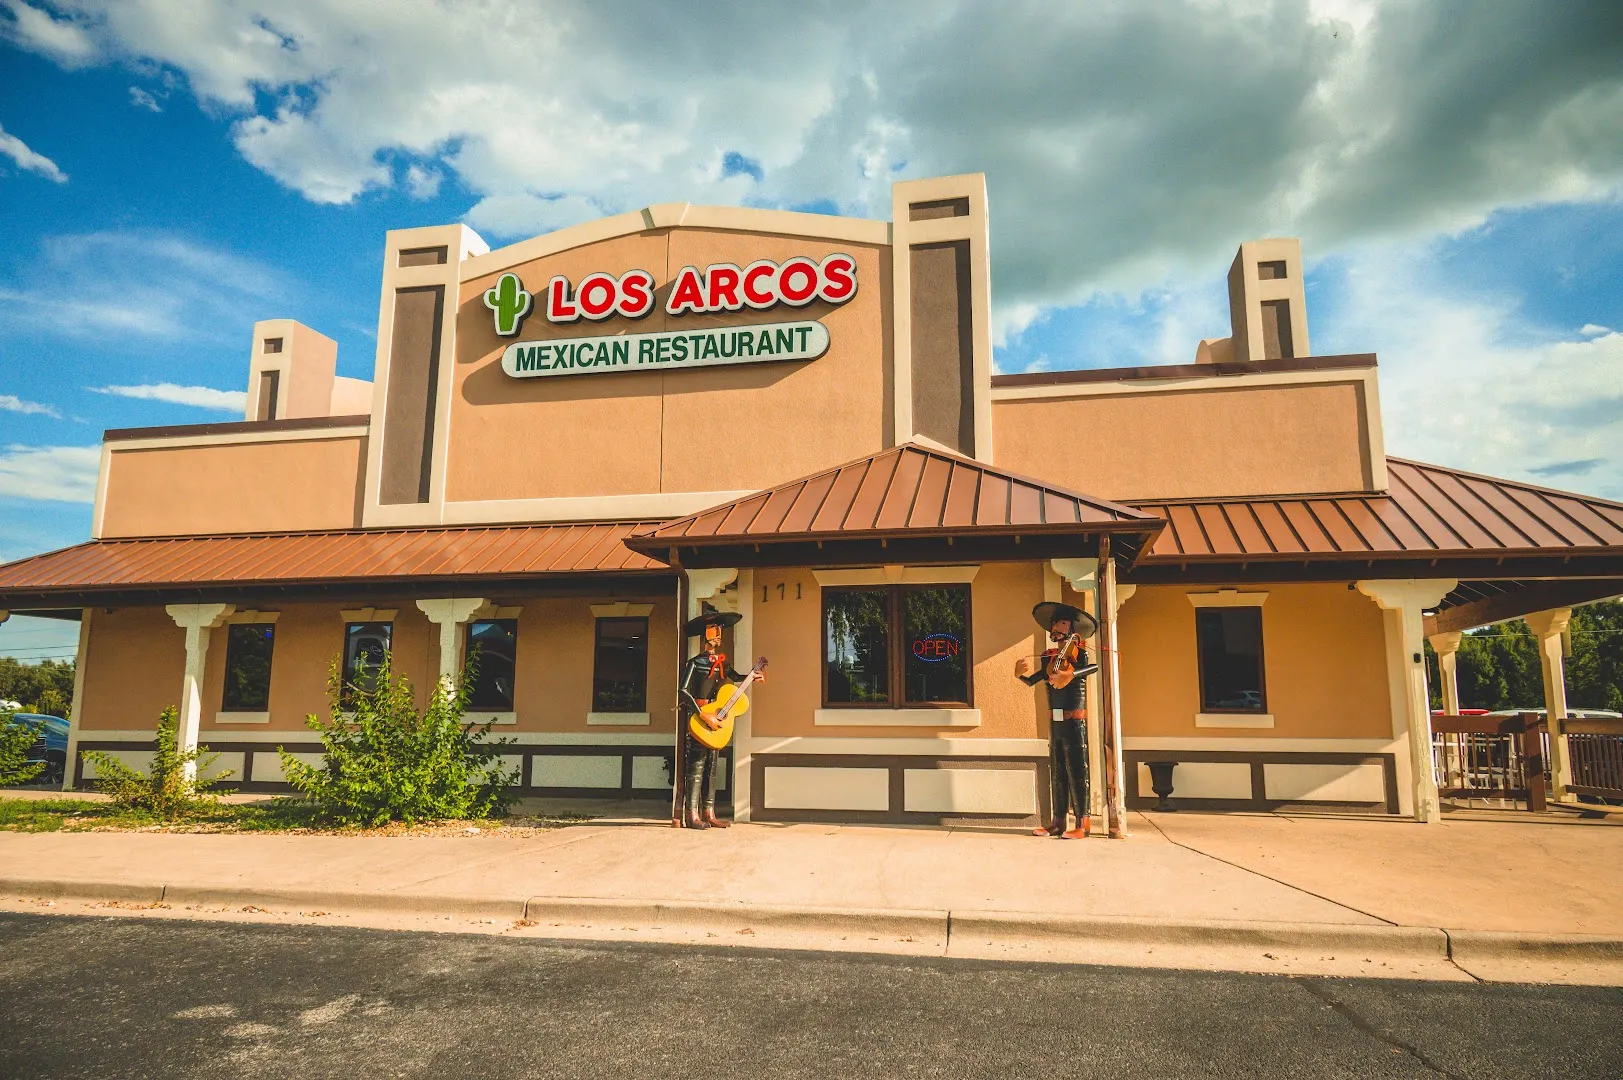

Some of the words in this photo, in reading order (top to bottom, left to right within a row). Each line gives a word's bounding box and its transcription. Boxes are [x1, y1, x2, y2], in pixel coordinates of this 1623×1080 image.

[552, 275, 650, 317] LOS
[670, 258, 854, 310] ARCOS
[515, 340, 630, 372] MEXICAN
[638, 326, 813, 364] RESTAURANT
[761, 582, 802, 603] 171
[912, 639, 959, 656] OPEN
